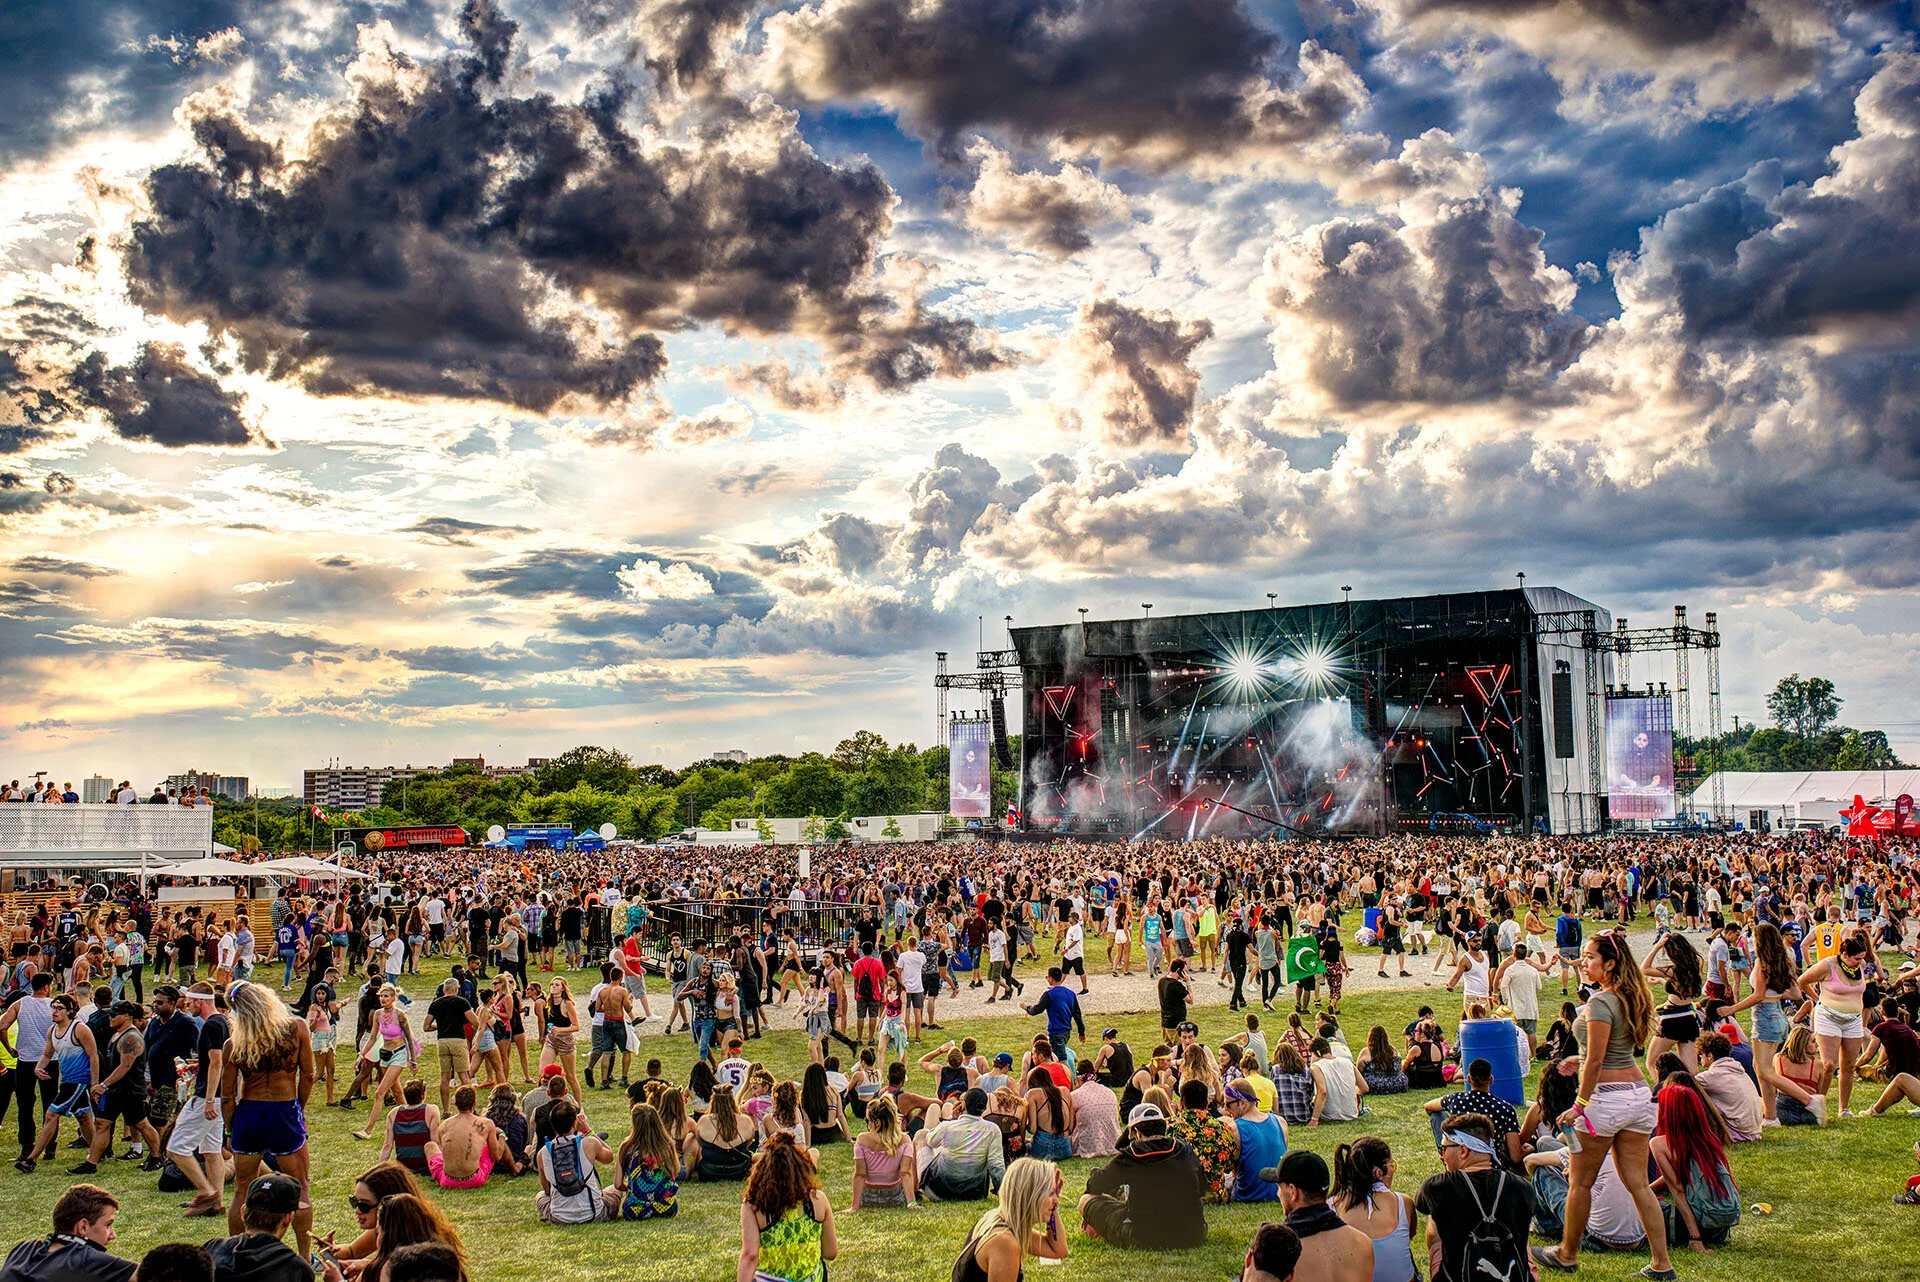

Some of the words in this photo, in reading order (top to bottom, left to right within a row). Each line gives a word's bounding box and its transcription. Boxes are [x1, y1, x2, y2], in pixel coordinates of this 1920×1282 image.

[1848, 806, 1867, 824] Virgin
[64, 922, 71, 934] 0
[280, 932, 290, 943] 10
[1823, 934, 1833, 948] 8
[724, 1062, 747, 1070] WRIGHT
[730, 1069, 740, 1086] 5
